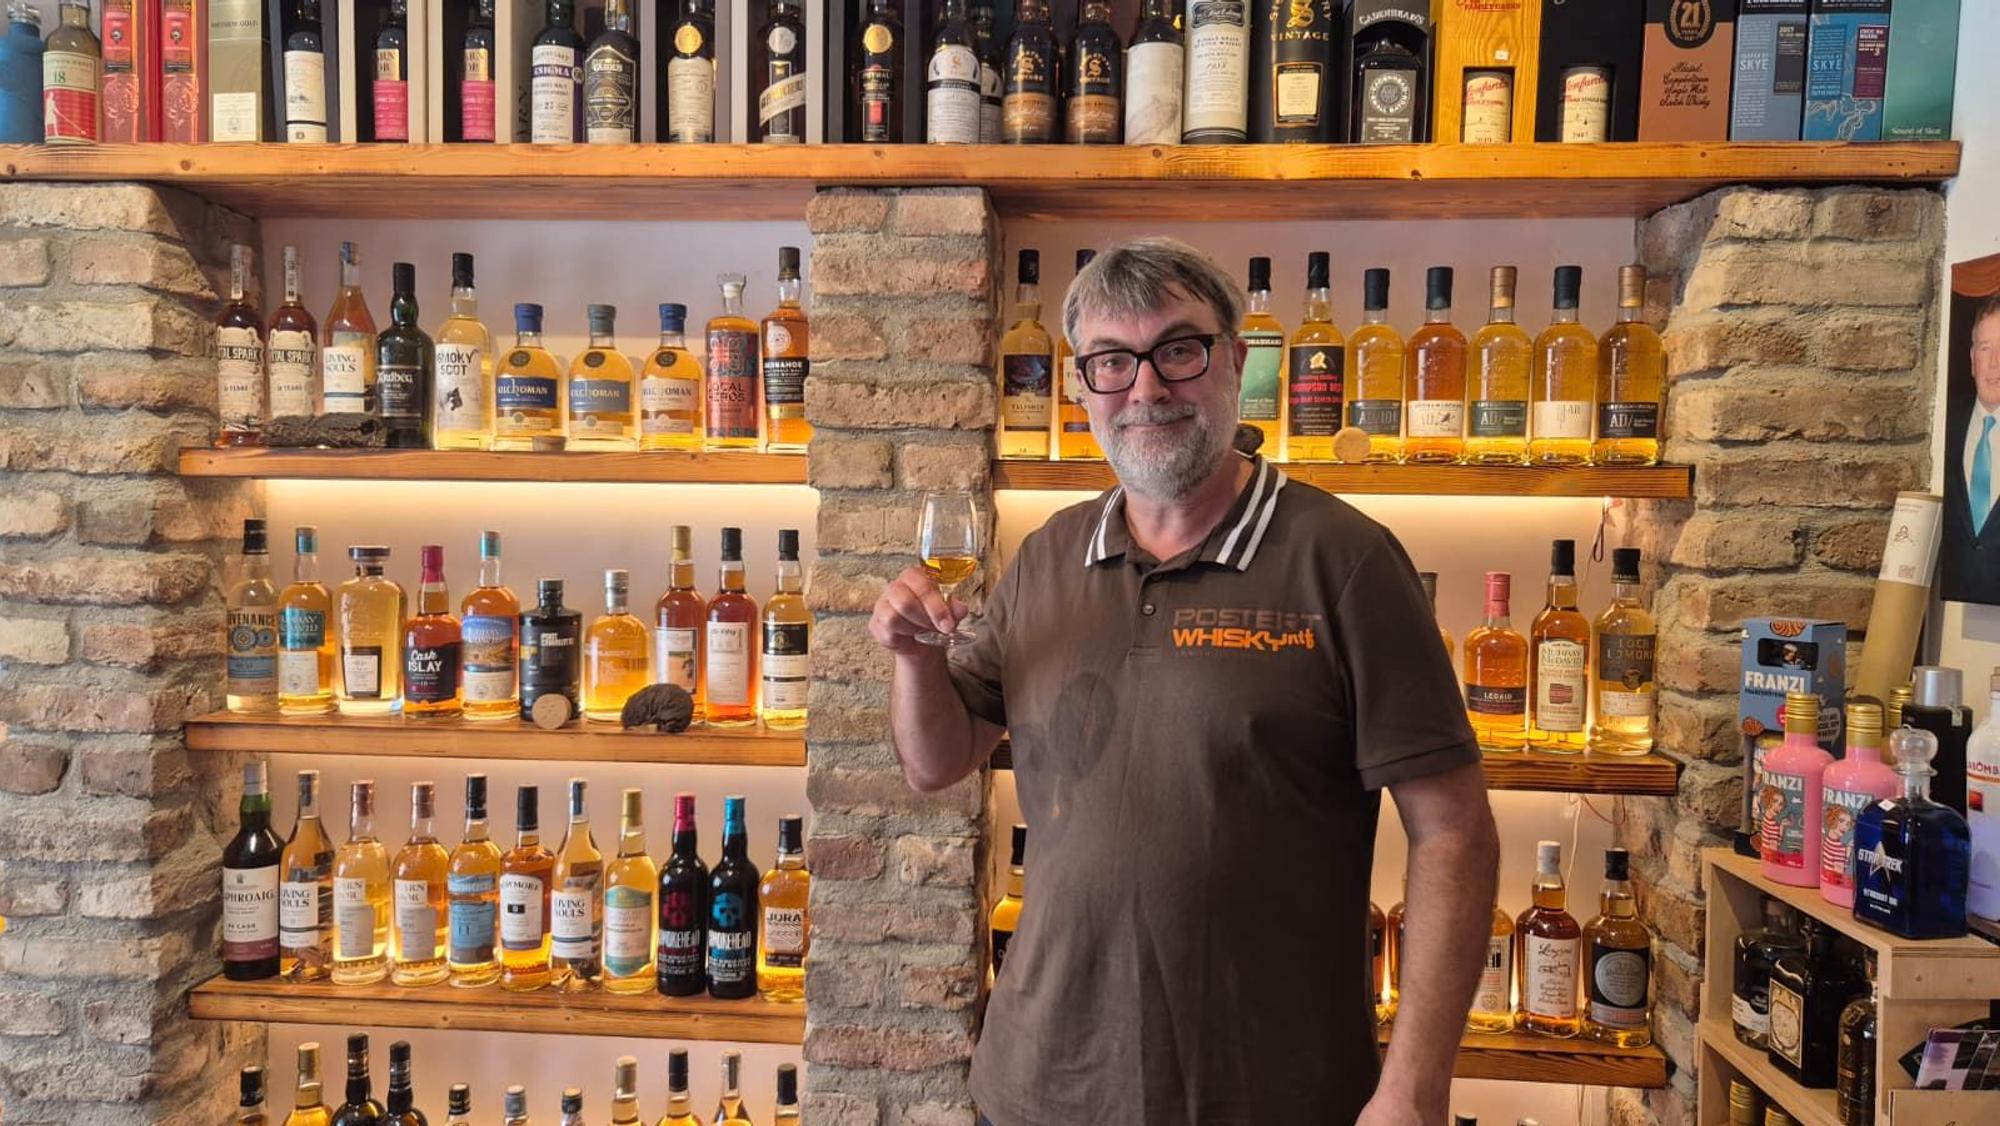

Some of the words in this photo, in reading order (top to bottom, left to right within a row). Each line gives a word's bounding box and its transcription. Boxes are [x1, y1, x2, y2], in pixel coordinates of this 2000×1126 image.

[1681, 2, 1700, 27] 21
[1271, 31, 1330, 42] VINTAGE
[1740, 59, 1769, 71] SKYE
[1812, 60, 1841, 71] SKYE
[54, 71, 67, 83] 18
[441, 364, 468, 376] SCOT
[408, 660, 442, 672] ISLAY
[1745, 671, 1805, 695] FRANZI
[1764, 770, 1804, 792] RANZI
[767, 911, 802, 922] JURA
